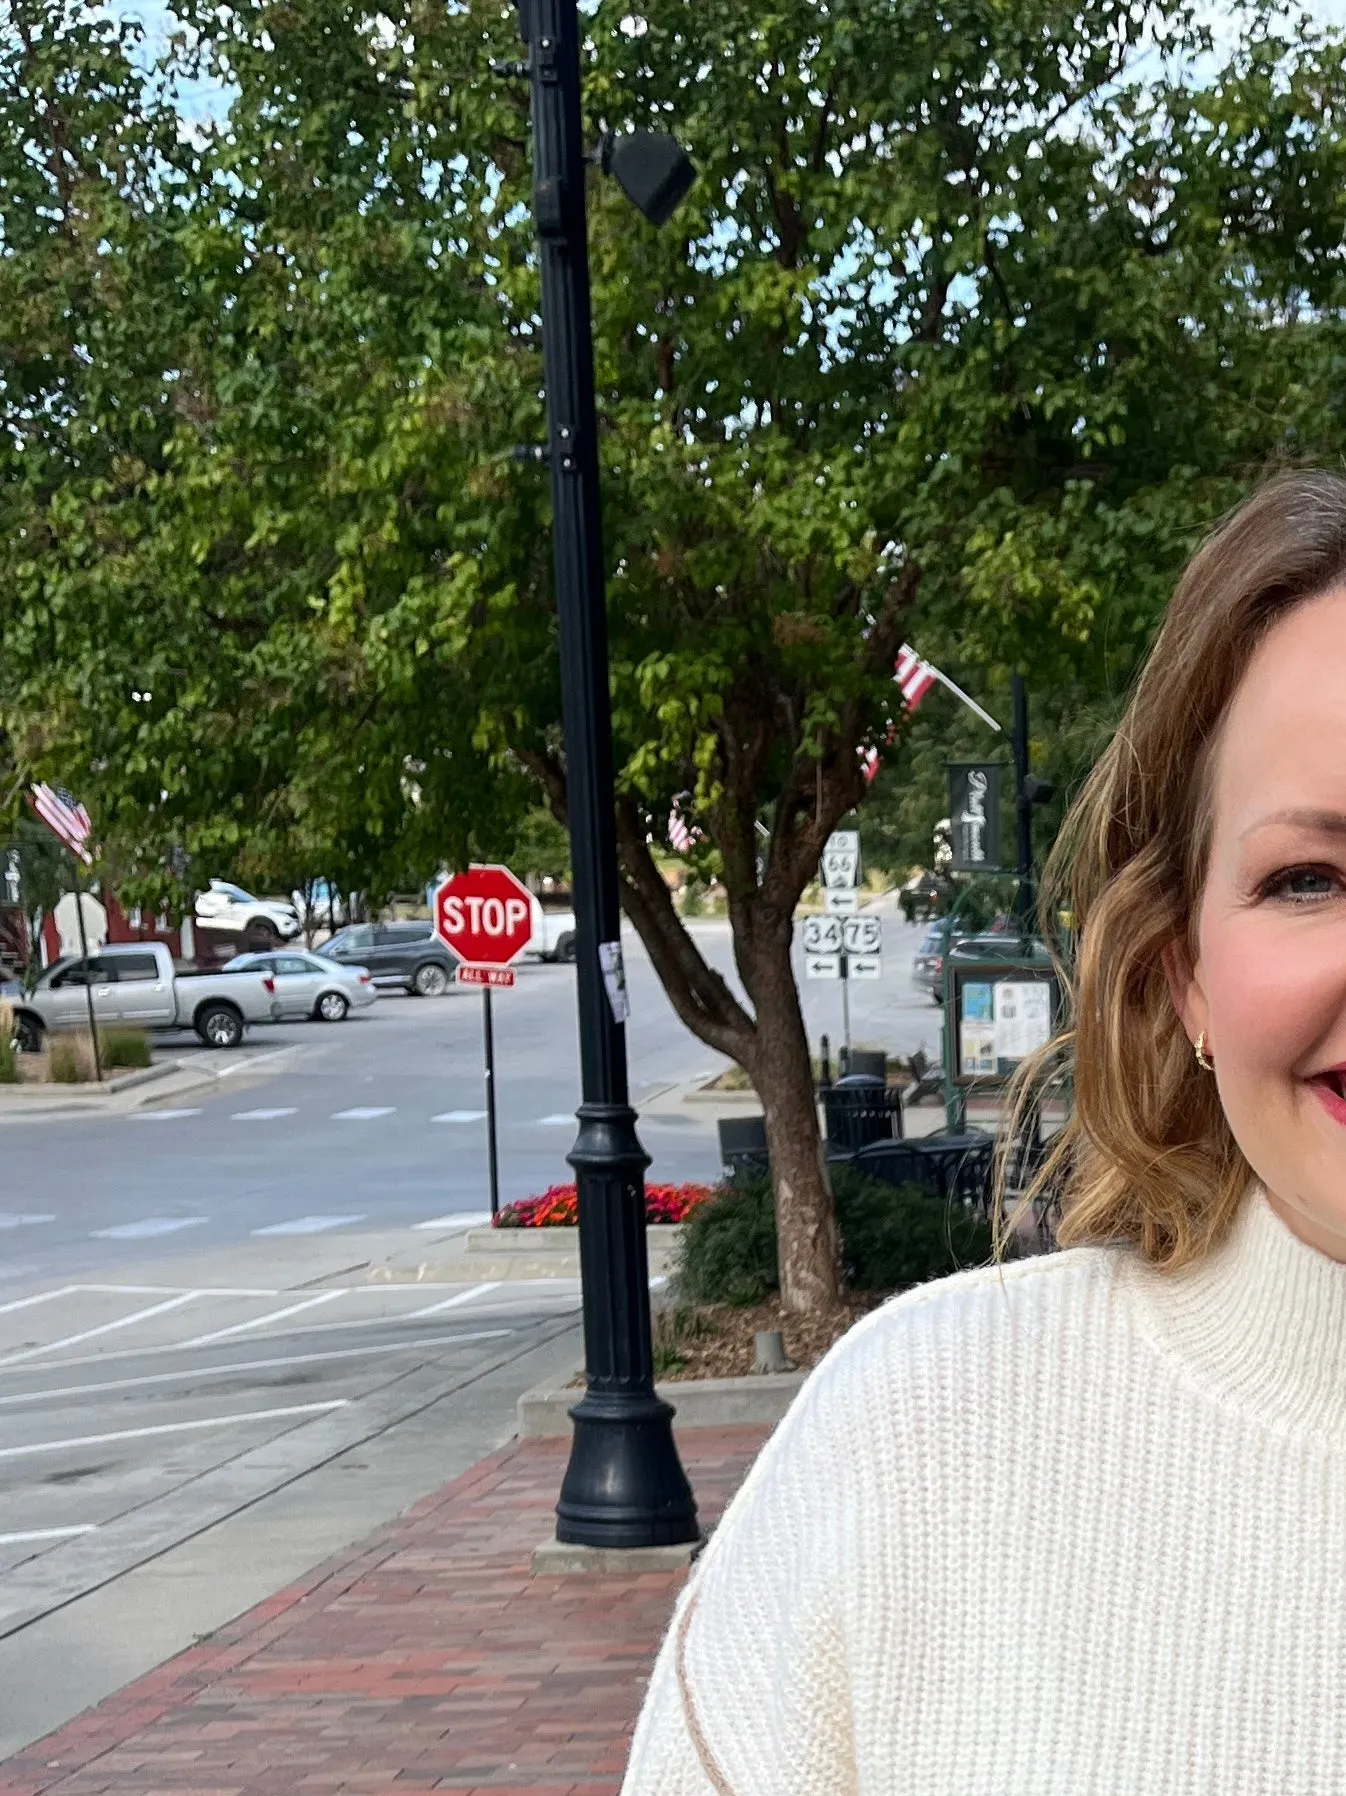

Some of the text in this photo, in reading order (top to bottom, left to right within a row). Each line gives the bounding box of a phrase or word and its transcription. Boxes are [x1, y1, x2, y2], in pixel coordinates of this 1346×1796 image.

[828, 856, 852, 873] 66
[442, 895, 528, 937] STOP
[809, 920, 837, 945] 34
[847, 923, 878, 946] 75
